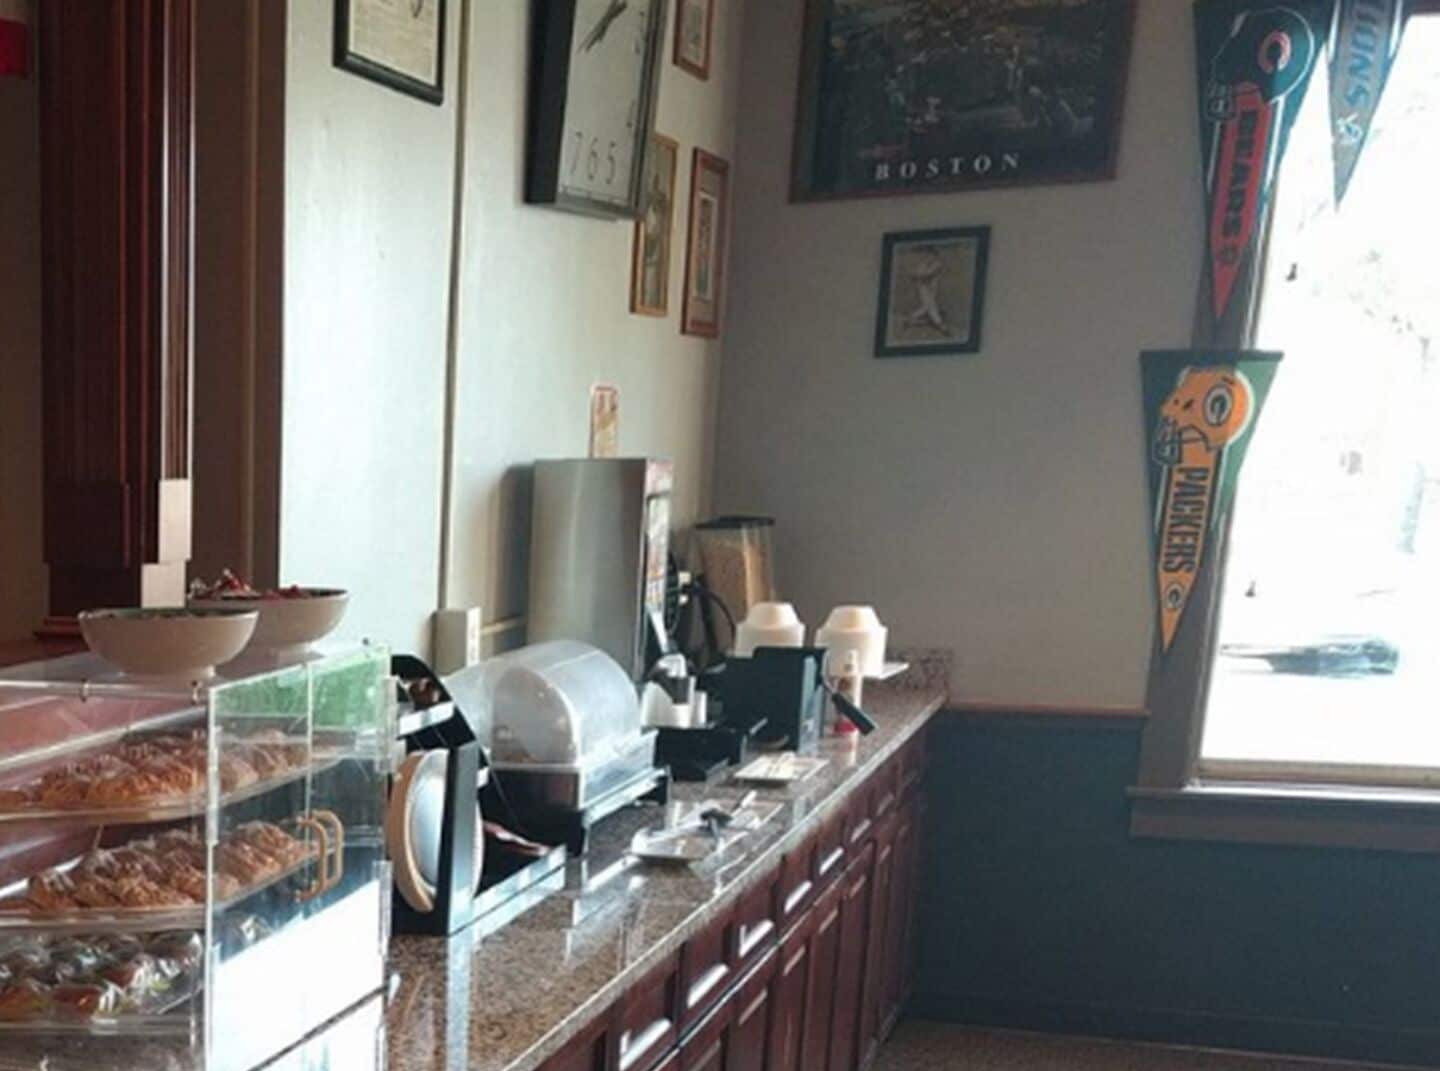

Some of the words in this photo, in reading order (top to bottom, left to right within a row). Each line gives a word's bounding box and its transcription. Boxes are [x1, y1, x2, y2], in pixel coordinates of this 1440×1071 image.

[586, 136, 599, 182] 6
[605, 140, 616, 185] 5
[874, 151, 1020, 182] BOSTON
[1162, 466, 1210, 573] PACKERS
